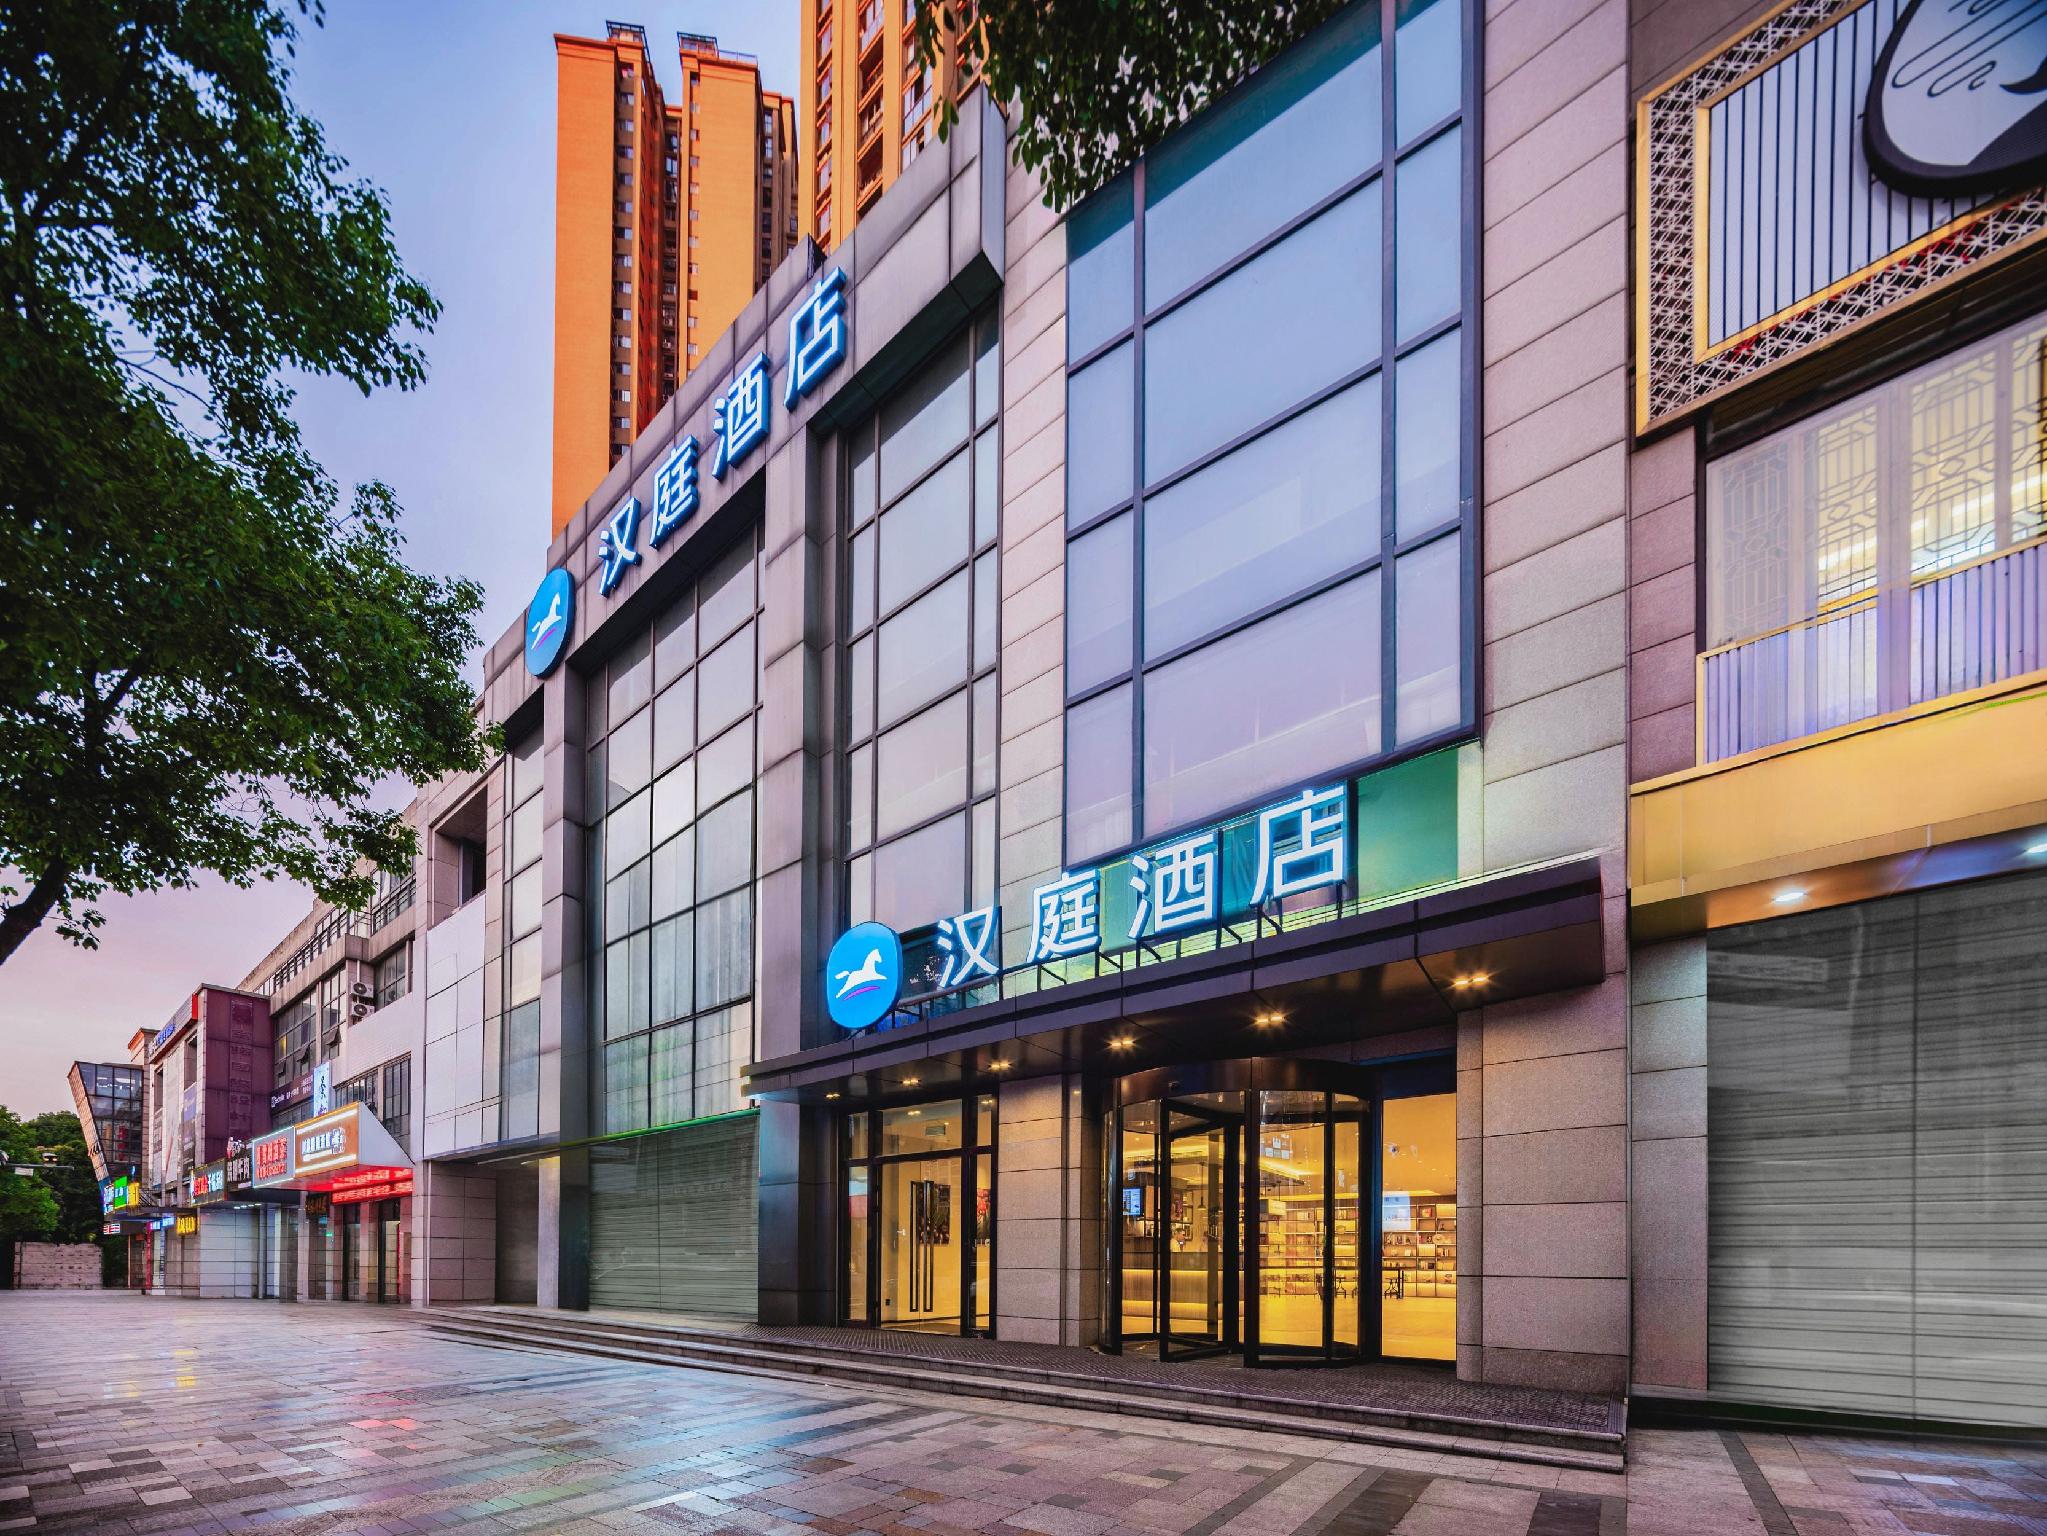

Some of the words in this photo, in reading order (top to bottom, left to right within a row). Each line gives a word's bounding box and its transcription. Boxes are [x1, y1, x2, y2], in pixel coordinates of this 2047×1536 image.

[599, 266, 846, 597] 汉庭酒店
[936, 785, 1346, 988] 汉庭酒店
